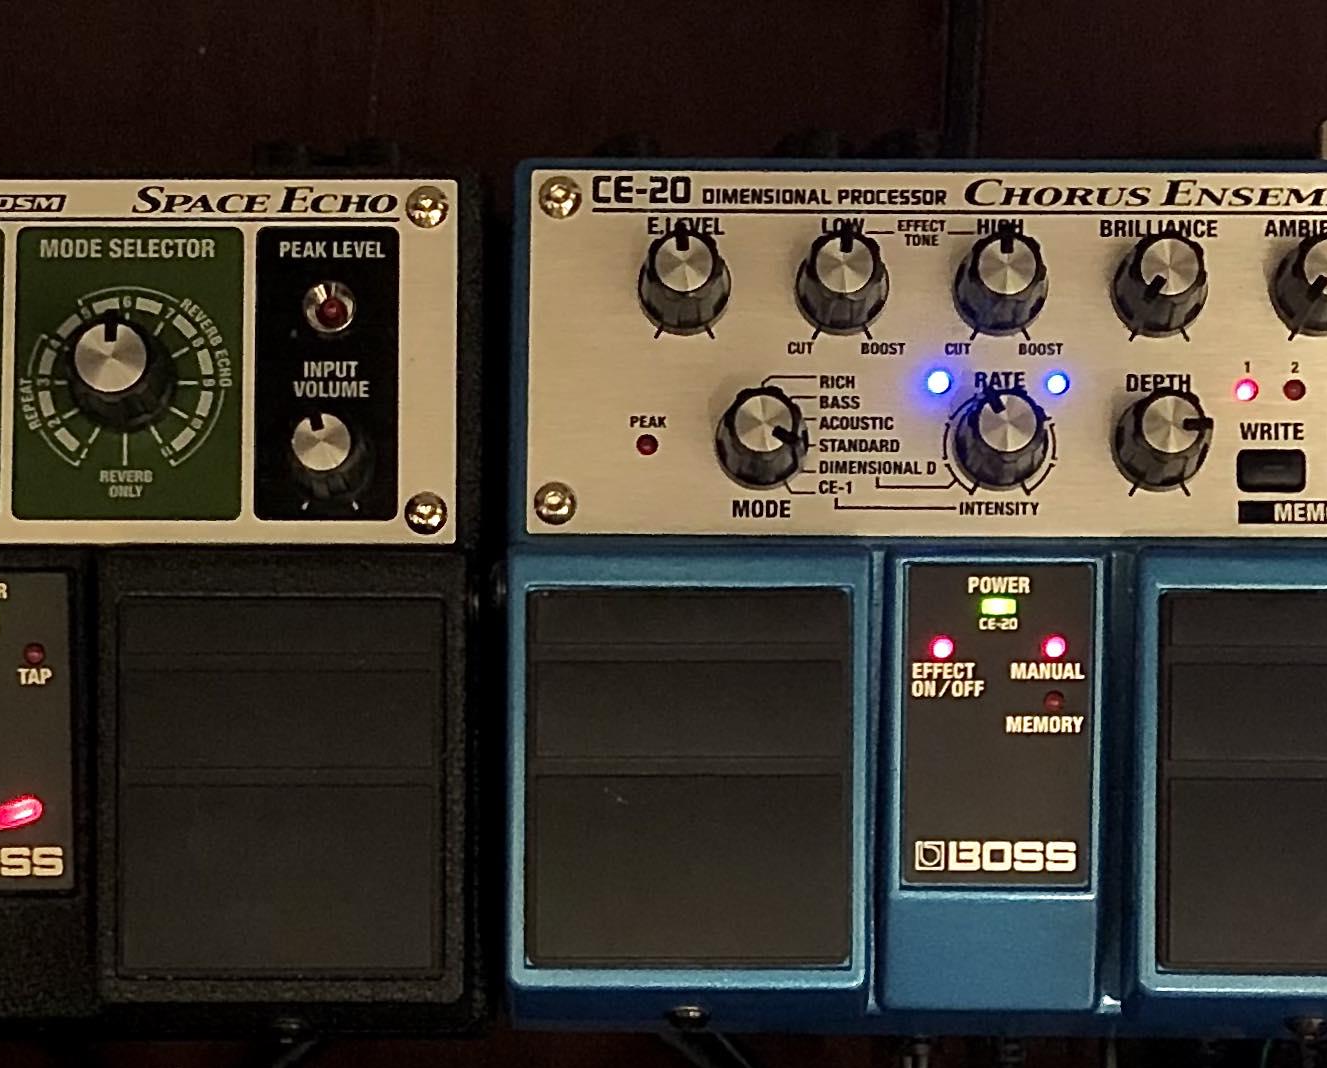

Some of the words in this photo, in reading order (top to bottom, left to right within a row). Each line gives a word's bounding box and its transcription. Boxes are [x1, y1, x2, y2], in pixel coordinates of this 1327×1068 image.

[592, 176, 691, 204] CE-20
[702, 188, 831, 205] DIMENSIONAL
[838, 189, 947, 205] PROCESSOR
[968, 179, 1152, 207] CHORUS
[131, 187, 269, 214] SPACE
[277, 187, 398, 214] ECHO
[897, 220, 946, 232] EFFECT
[1099, 220, 1217, 237] BRILLIANCE
[39, 239, 104, 258] MODE
[109, 239, 216, 258] SELECTOR
[905, 234, 938, 246] TONE
[279, 241, 327, 258] PEAK
[333, 241, 385, 258] LEVEL
[179, 298, 223, 347] REVERB
[215, 349, 232, 387] ECHO
[787, 342, 813, 356] CUT
[860, 342, 905, 356] BOOST
[944, 342, 971, 356] CUT
[1018, 343, 1063, 356] BOOST
[303, 361, 357, 379] INPUT
[293, 380, 369, 398] VOLUME
[819, 374, 856, 390] RICH
[974, 372, 1025, 389] RATE
[1126, 374, 1191, 392] DEPTH
[19, 377, 42, 430] REPEAT
[819, 395, 860, 410] BASS
[630, 416, 666, 429] PEAK
[819, 416, 895, 431] ACOUSTIC
[1239, 423, 1305, 441] WRITE
[819, 438, 900, 453] STANDARD
[819, 460, 921, 475] DIMENSIONAL
[925, 460, 937, 475] D
[100, 471, 153, 483] REVERB
[109, 485, 143, 498] ONLY
[818, 481, 852, 494] CE-1
[731, 500, 791, 519] MODE
[959, 502, 1039, 516] INTENSITY
[968, 577, 1030, 594] POWER
[18, 669, 52, 684] TAP
[912, 663, 975, 680] EFFECT
[1010, 663, 1085, 680] MANUAL
[911, 681, 985, 698] ON/OFF
[1005, 716, 1084, 734] MEMORY
[948, 841, 1077, 871] BOSS
